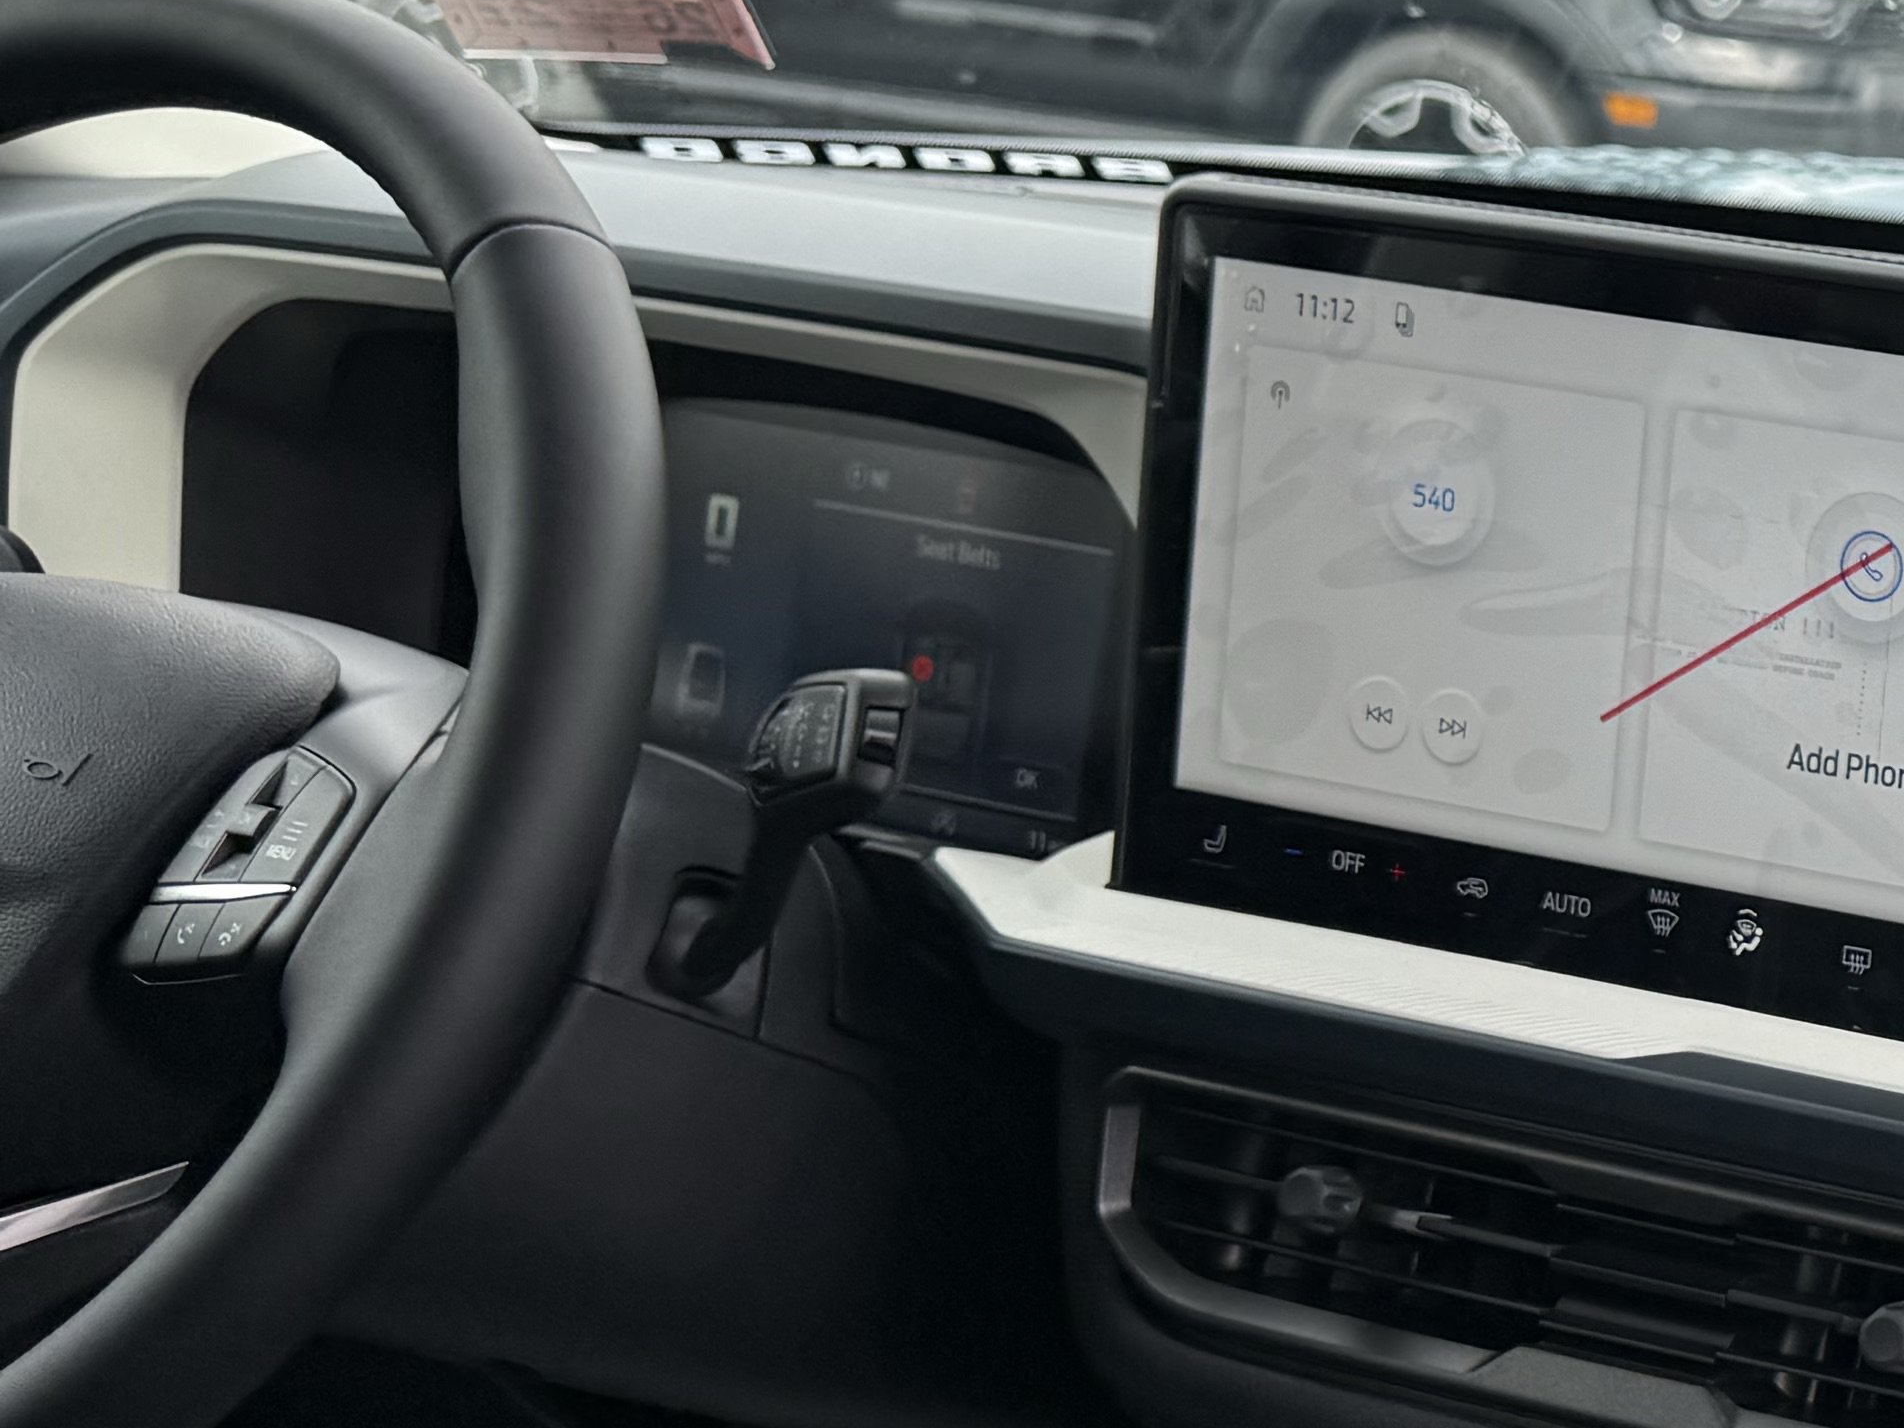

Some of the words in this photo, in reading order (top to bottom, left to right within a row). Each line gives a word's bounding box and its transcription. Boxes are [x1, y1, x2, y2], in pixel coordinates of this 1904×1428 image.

[1296, 293, 1355, 323] 11:12
[1412, 483, 1455, 512] 540
[1786, 743, 1839, 778] Add
[1331, 849, 1366, 874] OFF
[1542, 891, 1592, 918] AUTO
[1650, 889, 1680, 908] MAX
